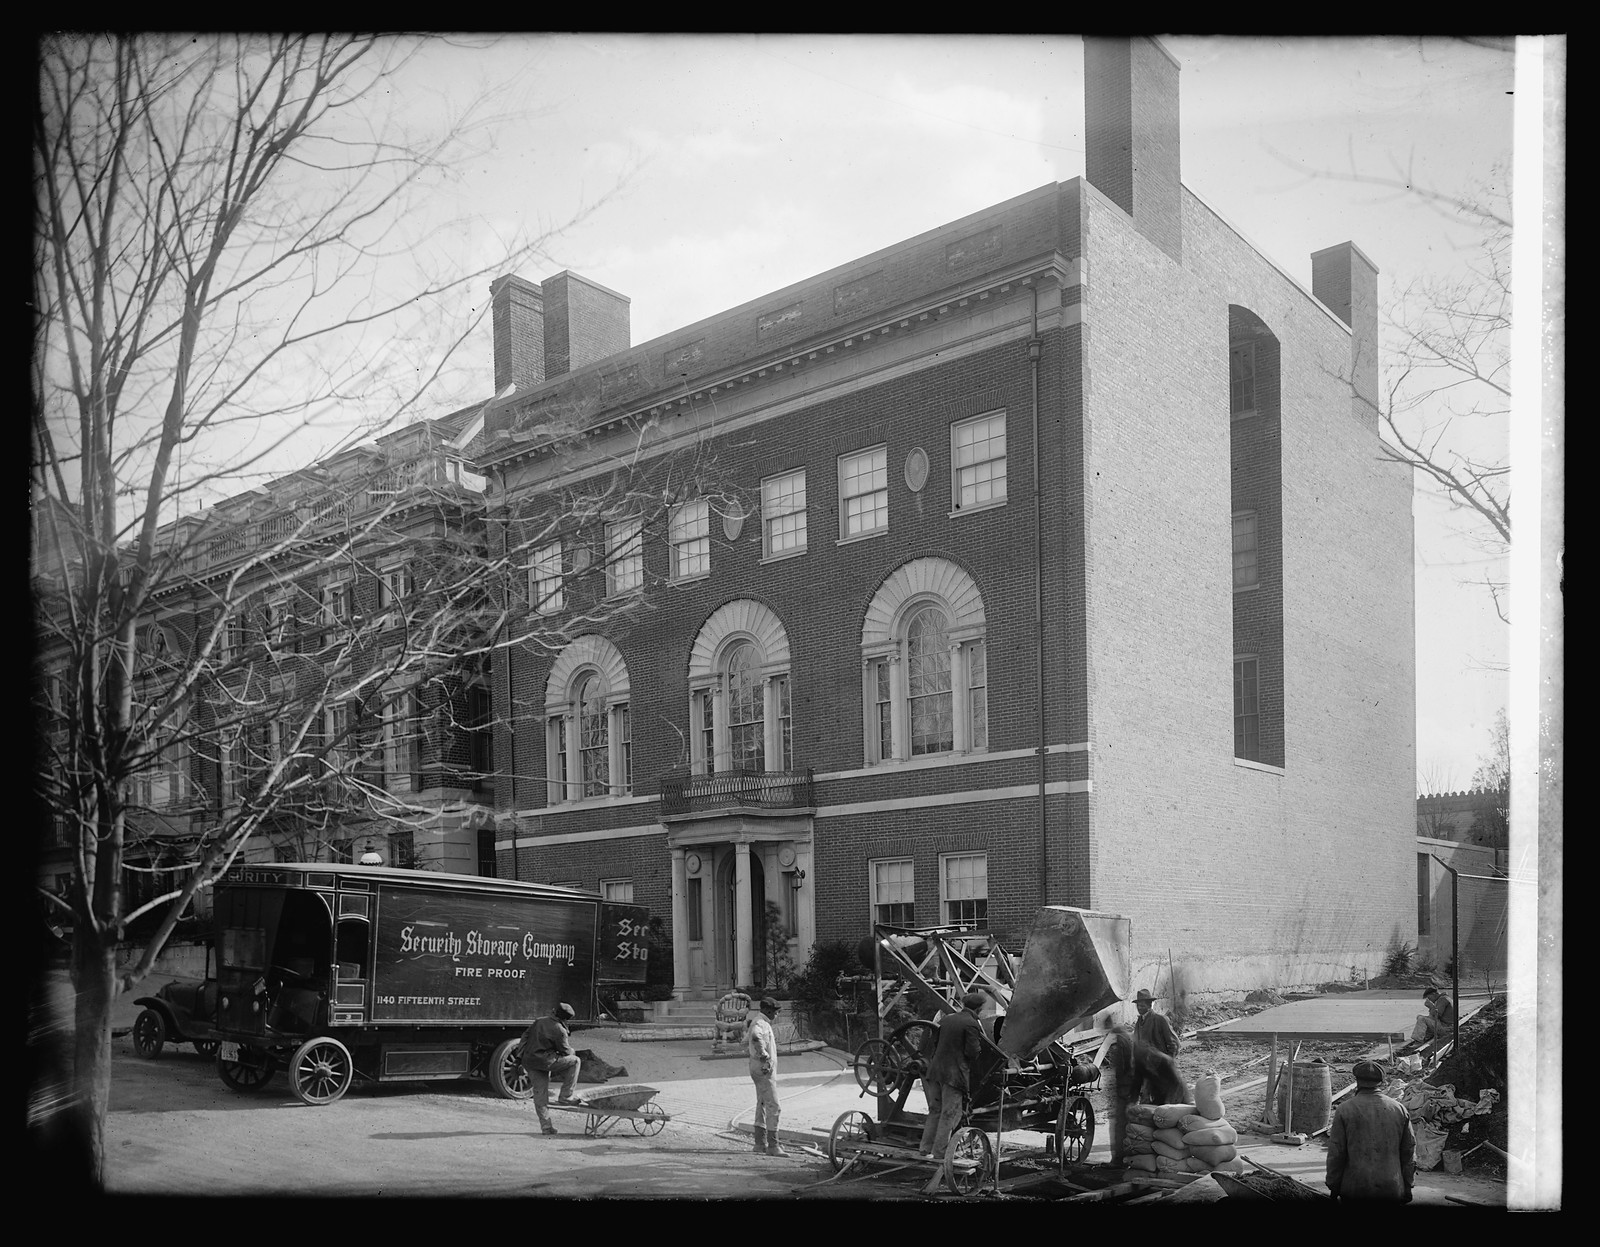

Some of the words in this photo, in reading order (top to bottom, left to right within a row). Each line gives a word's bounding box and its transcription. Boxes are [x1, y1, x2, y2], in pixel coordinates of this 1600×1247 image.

[400, 926, 462, 962] Security
[465, 930, 519, 964] Storage
[522, 931, 576, 967] Company
[614, 941, 648, 961] Sto
[455, 967, 483, 978] FIRE
[376, 995, 395, 1005] 1140
[398, 996, 445, 1006] FIFTEENTH
[447, 997, 482, 1006] STREET.
